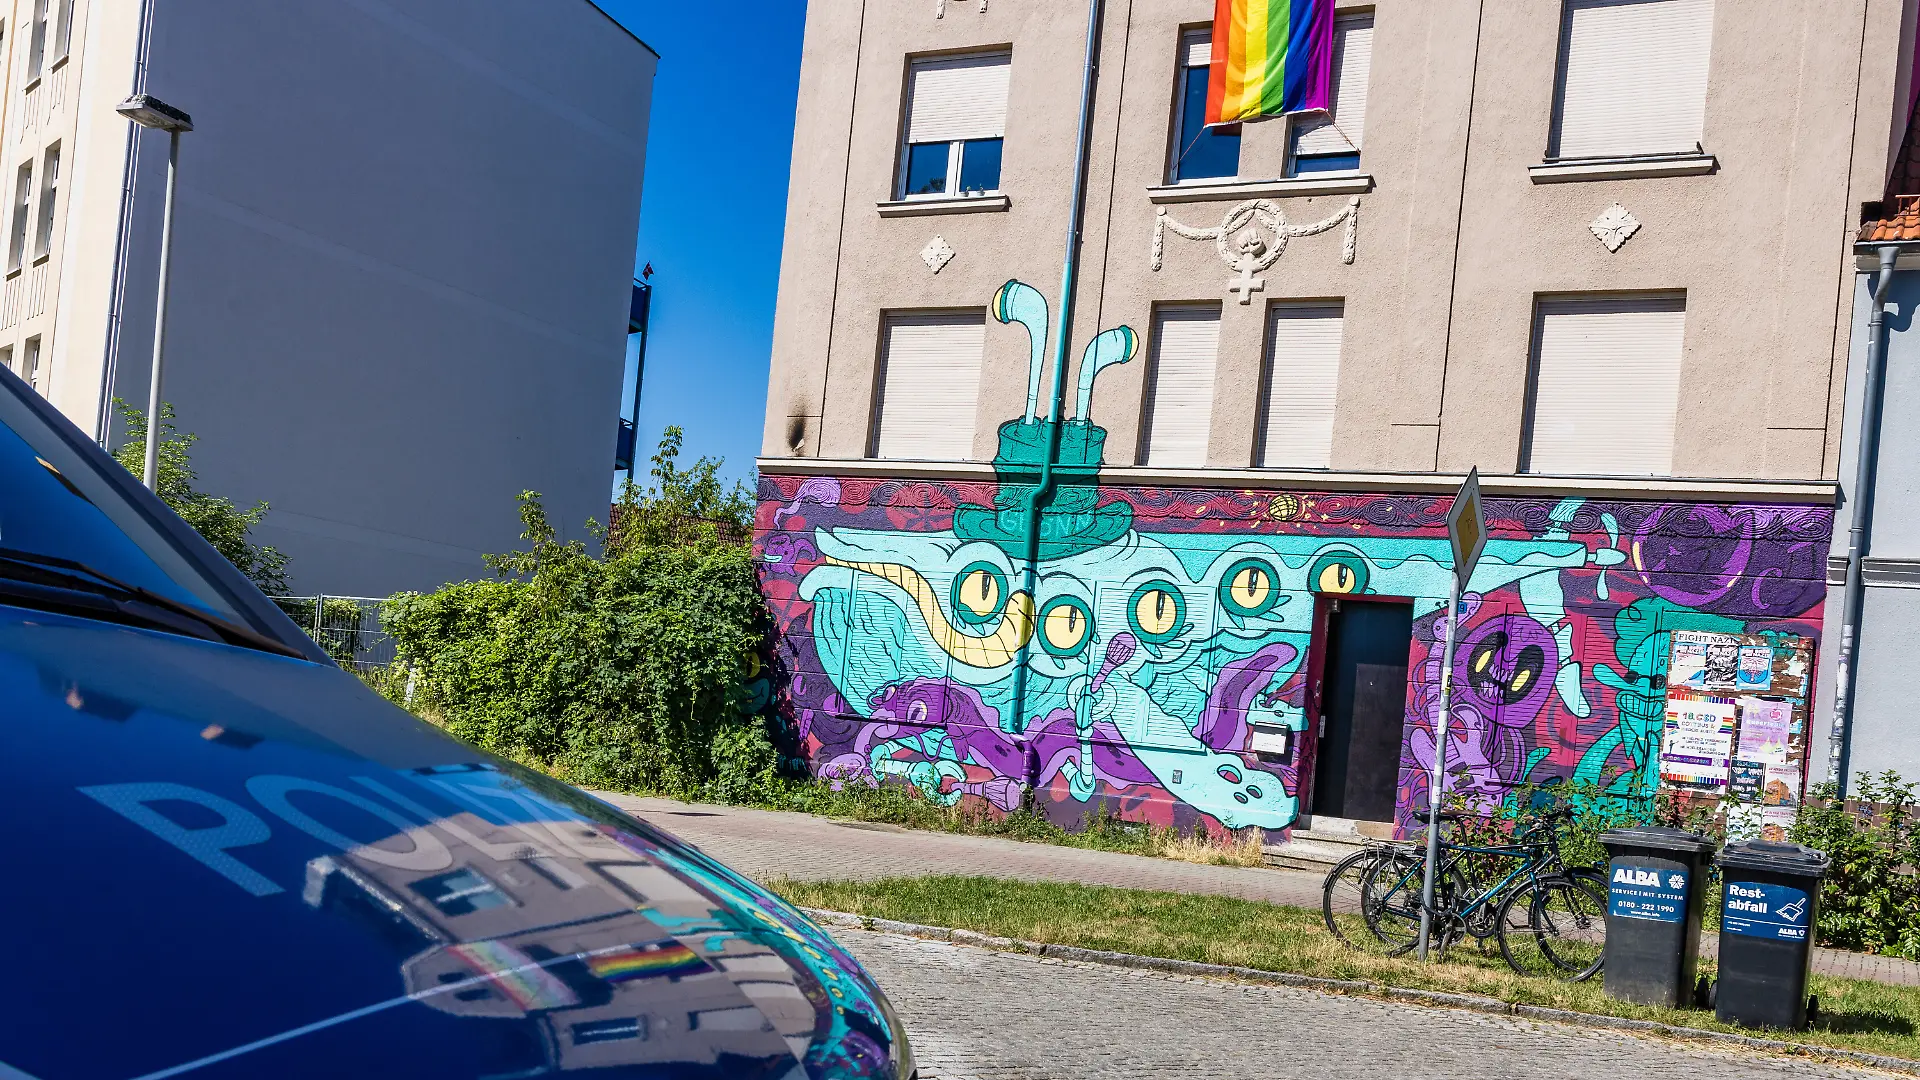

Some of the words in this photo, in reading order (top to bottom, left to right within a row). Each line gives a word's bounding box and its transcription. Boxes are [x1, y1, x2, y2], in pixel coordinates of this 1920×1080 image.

[1678, 633, 1708, 642] FIGHT
[1696, 713, 1717, 723] CSD
[1613, 868, 1661, 888] ALBA
[1611, 888, 1637, 896] SERVICE
[1657, 893, 1684, 901] SYSTEM
[1729, 884, 1766, 899] Rest-
[1618, 900, 1635, 909] 0180
[1641, 903, 1655, 911] 222
[1657, 904, 1675, 913] 1990
[1727, 899, 1768, 914] abfall
[1778, 927, 1798, 936] ALBA
